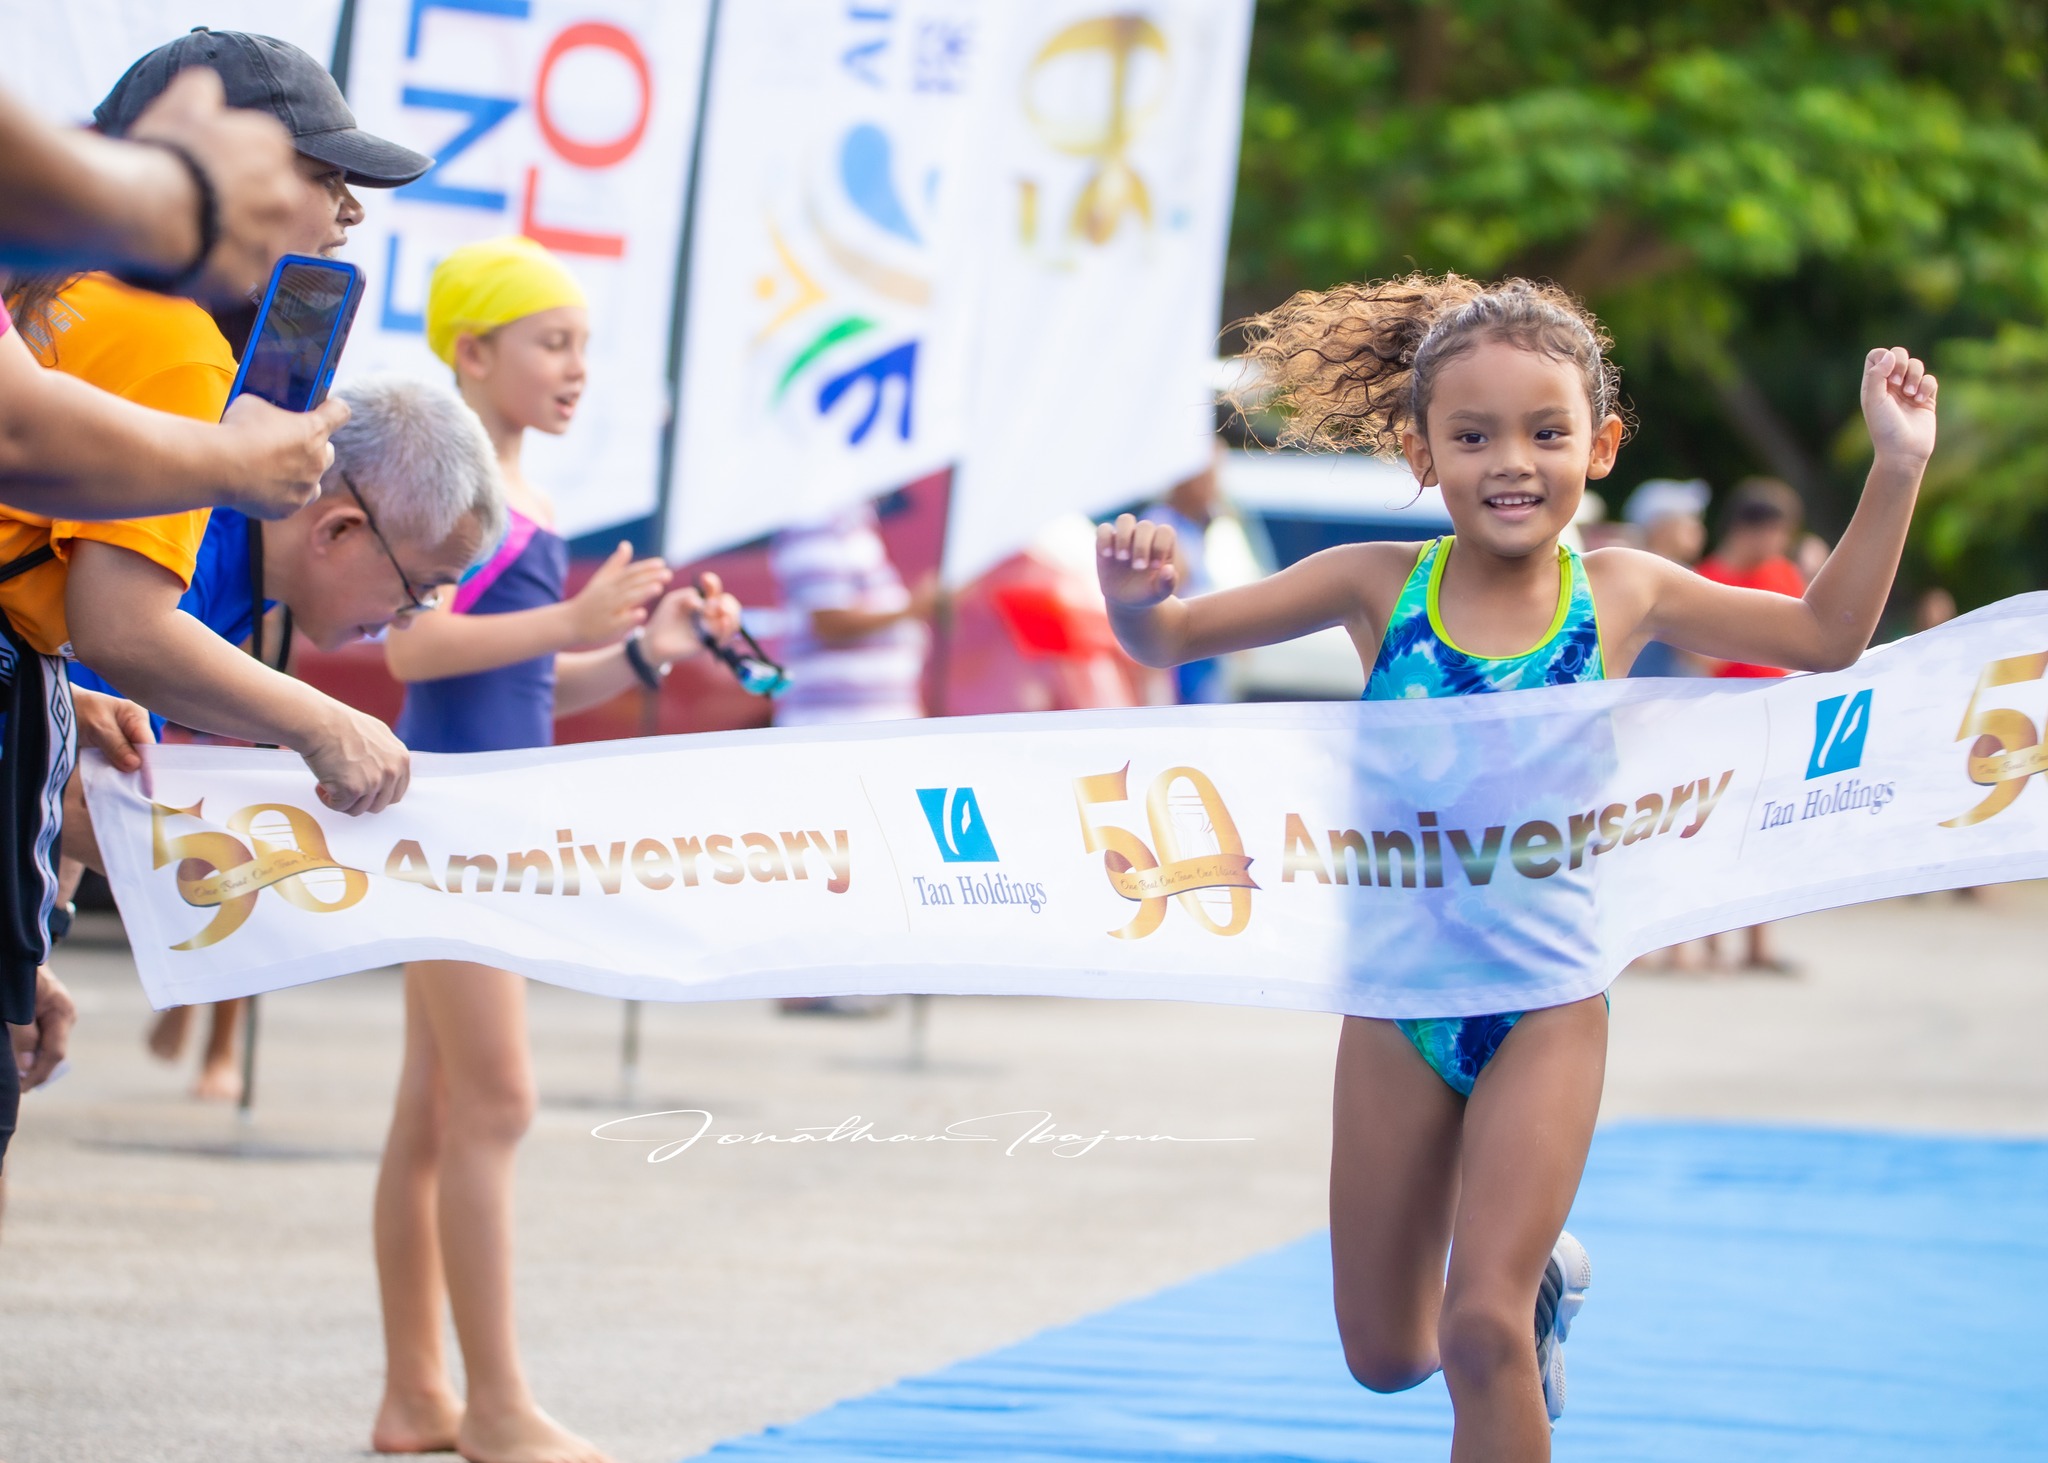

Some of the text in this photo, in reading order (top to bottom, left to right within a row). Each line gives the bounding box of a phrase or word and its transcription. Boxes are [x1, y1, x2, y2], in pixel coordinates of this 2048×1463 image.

[1937, 650, 2048, 829] 5
[1760, 778, 1896, 832] Tan Holdings
[384, 827, 850, 894] Anniversary
[1072, 759, 1735, 940] 50 Anniversary
[912, 872, 1047, 914] Tan Holdings
